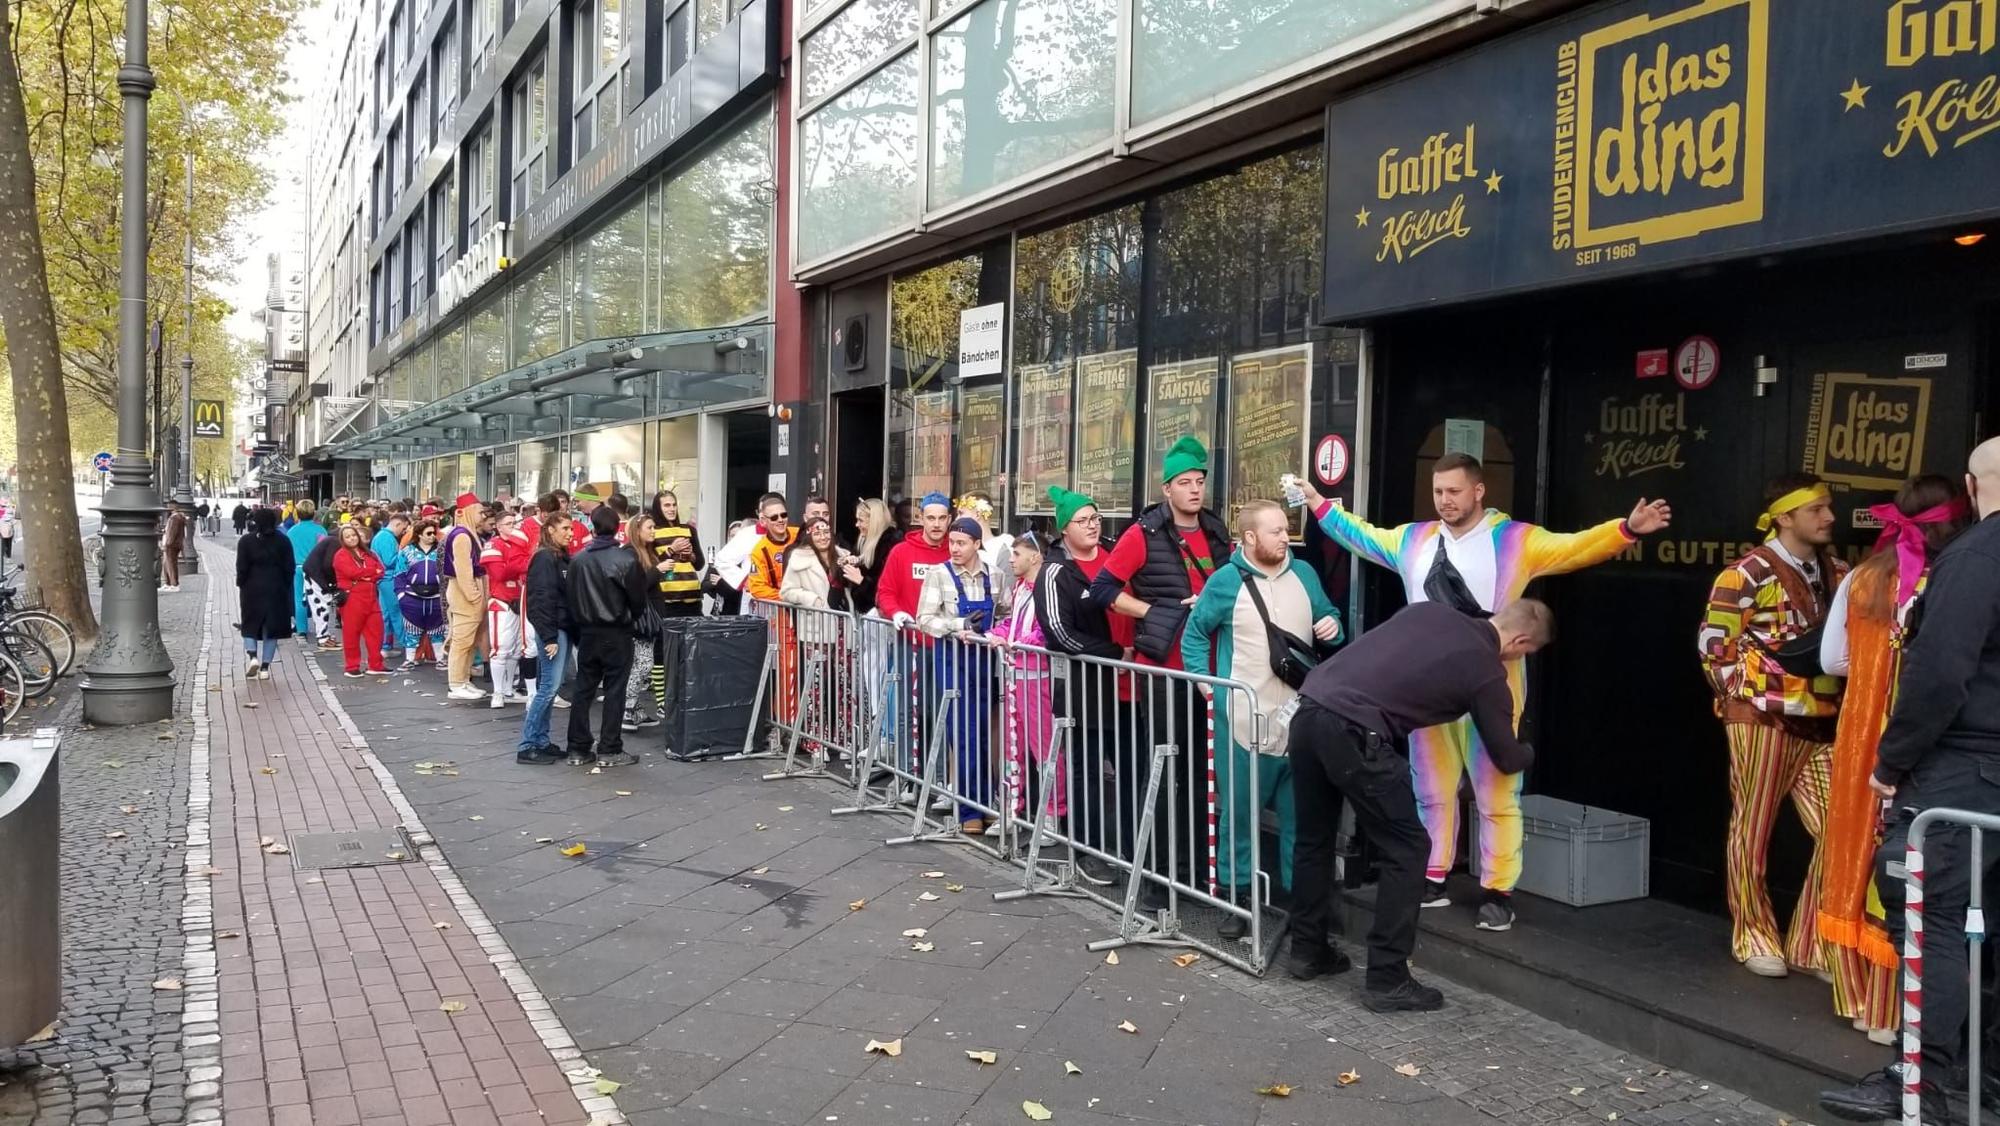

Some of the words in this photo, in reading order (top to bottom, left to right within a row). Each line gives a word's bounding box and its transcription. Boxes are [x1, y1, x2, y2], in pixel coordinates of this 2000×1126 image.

[1638, 42, 1731, 105] das
[633, 79, 682, 168] günstig!
[1552, 40, 1577, 251] STUDENTENCLUB
[1594, 52, 1740, 197] ding
[1378, 122, 1479, 200] Gaffel
[1375, 193, 1472, 264] Kölsch
[1576, 248, 1602, 266] SEIT
[1606, 243, 1636, 262] 1968
[982, 319, 998, 331] ohne
[961, 349, 1000, 364] Bändchen
[1087, 367, 1126, 387] FREITAG
[1158, 379, 1210, 401] SAMSTAG
[1856, 390, 1910, 424] das
[1600, 392, 1687, 436] Gaffel
[1802, 373, 1826, 475] TUDENTENCLUB
[1828, 390, 1911, 471] ding
[1595, 434, 1685, 480] Kölsch
[1657, 540, 1754, 565] GUTES
